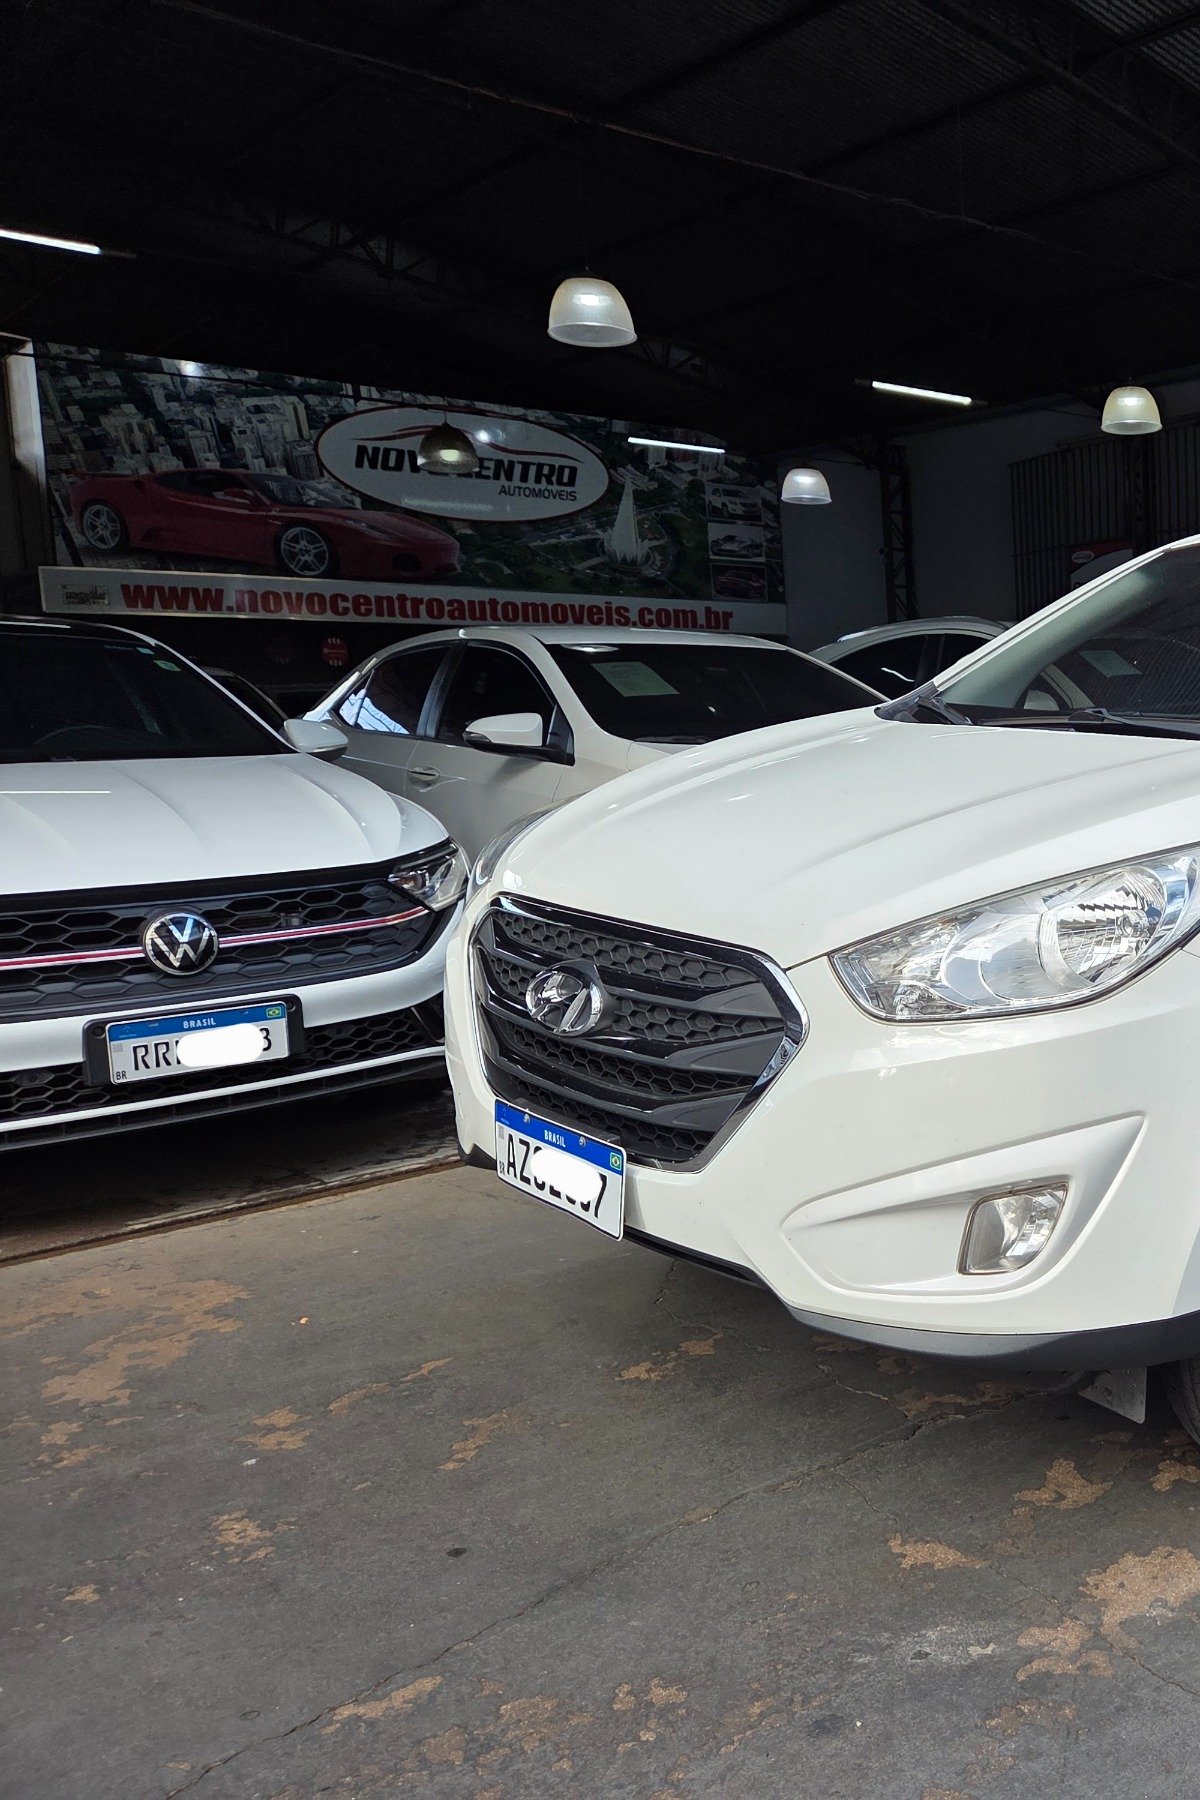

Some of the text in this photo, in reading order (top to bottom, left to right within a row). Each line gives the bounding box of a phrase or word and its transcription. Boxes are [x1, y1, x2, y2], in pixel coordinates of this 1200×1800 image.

[120, 583, 733, 630] www.novocentroautomoveis.com.br
[183, 1018, 216, 1029] BRASIL
[115, 1070, 128, 1080] BR
[544, 1129, 566, 1148] BRASIL
